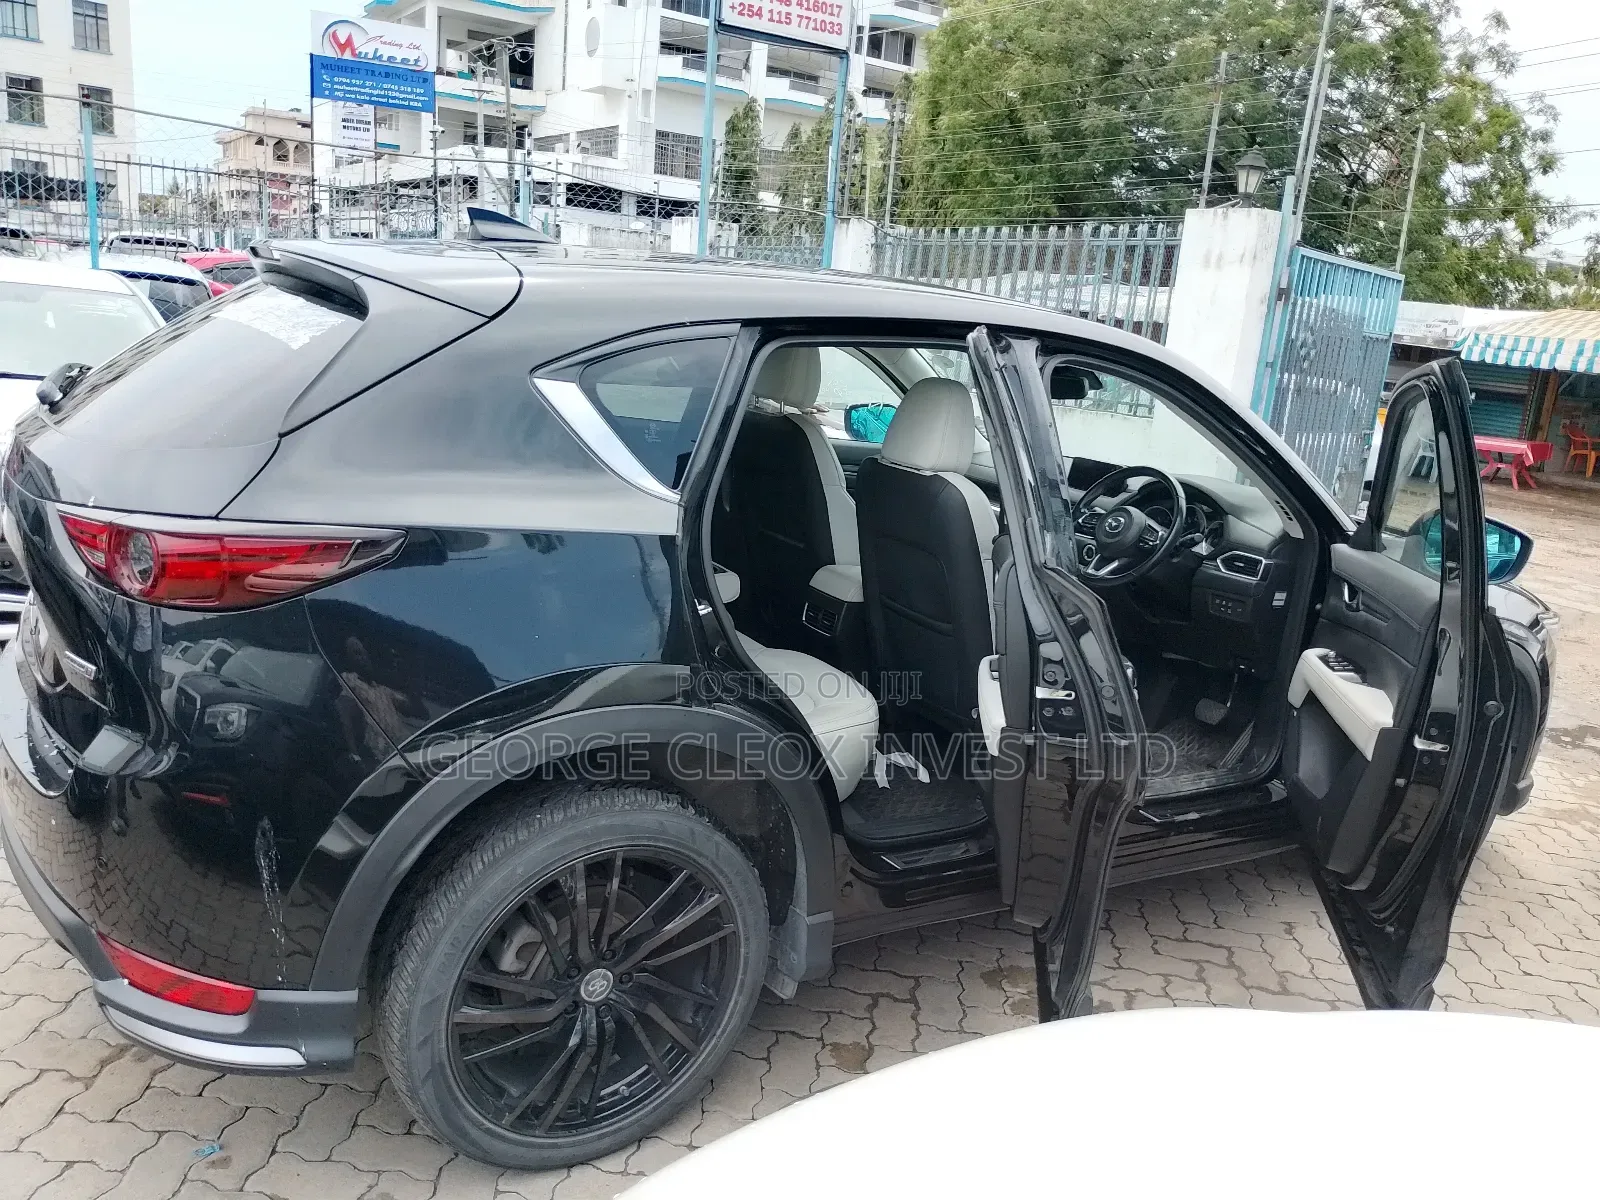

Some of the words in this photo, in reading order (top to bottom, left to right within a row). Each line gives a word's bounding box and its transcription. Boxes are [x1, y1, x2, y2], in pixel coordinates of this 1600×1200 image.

[729, 2, 763, 20] +254
[767, 8, 793, 25] 115
[796, 14, 843, 36] 771033
[796, 0, 843, 18] 416017
[329, 28, 422, 66] Muheet
[356, 34, 403, 50] Trading
[320, 62, 363, 75] MUHEET
[364, 69, 408, 82] TRADING
